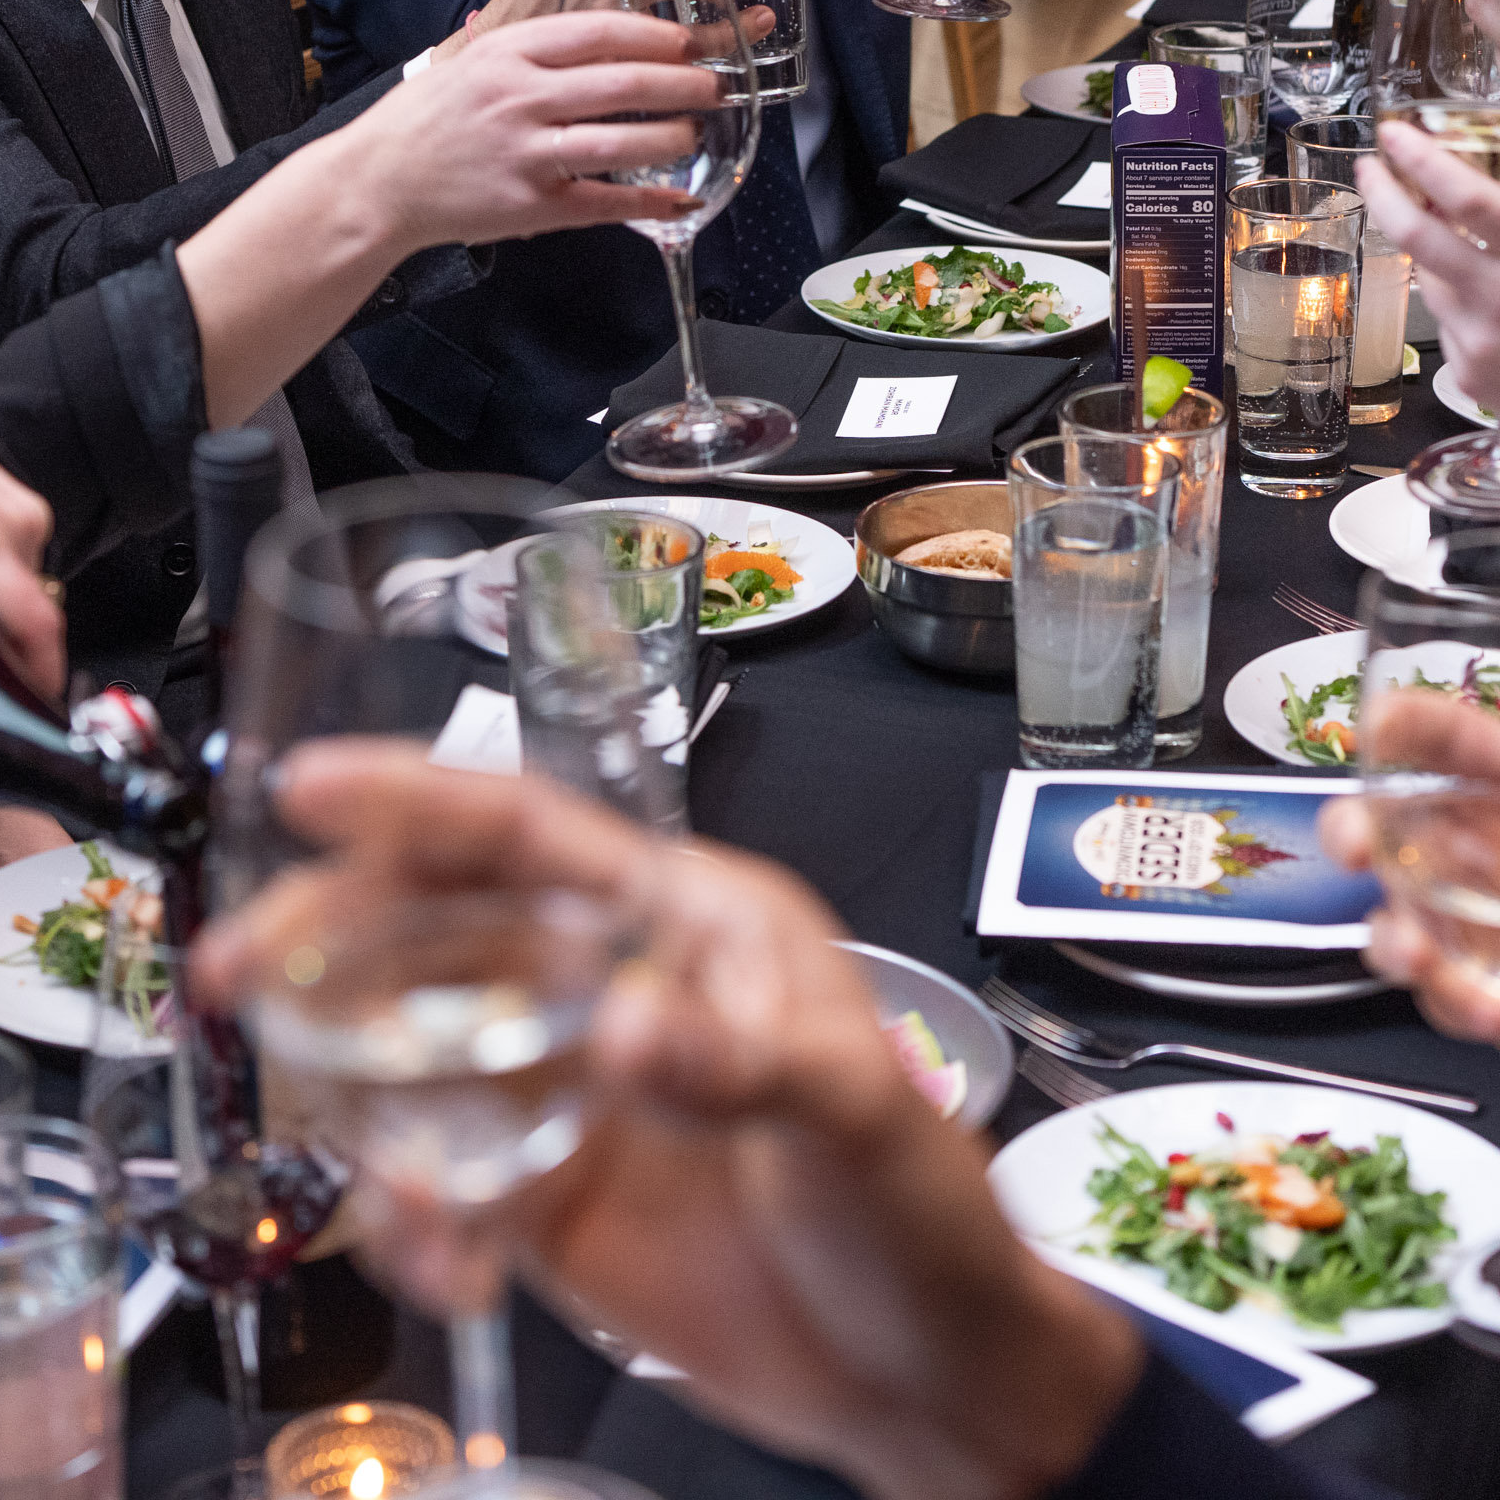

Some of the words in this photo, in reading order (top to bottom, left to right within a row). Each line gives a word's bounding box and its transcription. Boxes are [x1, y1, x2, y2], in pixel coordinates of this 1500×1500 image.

[1125, 161, 1178, 171] Nutrition
[1181, 161, 1214, 171] Facts
[1125, 203, 1178, 213] Calories
[1192, 200, 1214, 213] 80
[891, 399, 903, 415] MAYOR
[875, 406, 889, 428] MAMDANI
[1137, 813, 1184, 881] SEDER
